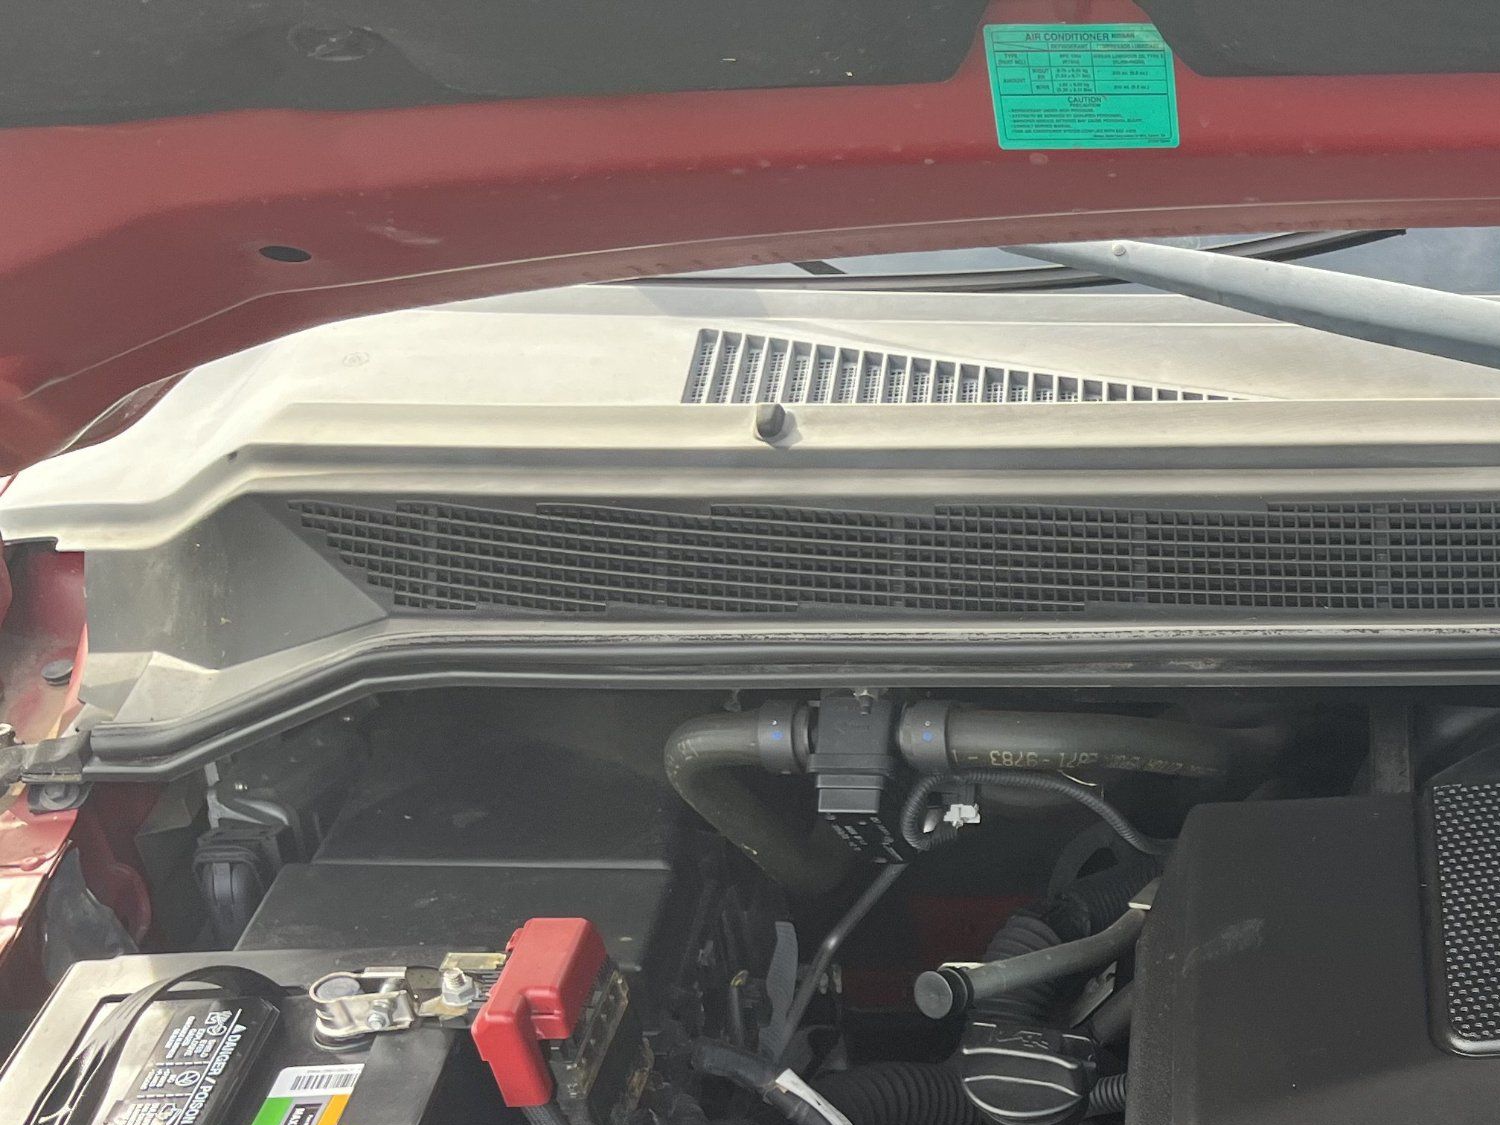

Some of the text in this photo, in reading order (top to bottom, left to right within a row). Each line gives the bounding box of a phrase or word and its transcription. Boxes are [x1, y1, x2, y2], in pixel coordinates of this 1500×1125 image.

[1026, 33, 1043, 41] AIR
[1044, 33, 1109, 41] CONDITIONER
[207, 1034, 242, 1076] DANGER
[180, 1085, 214, 1125] POISON
